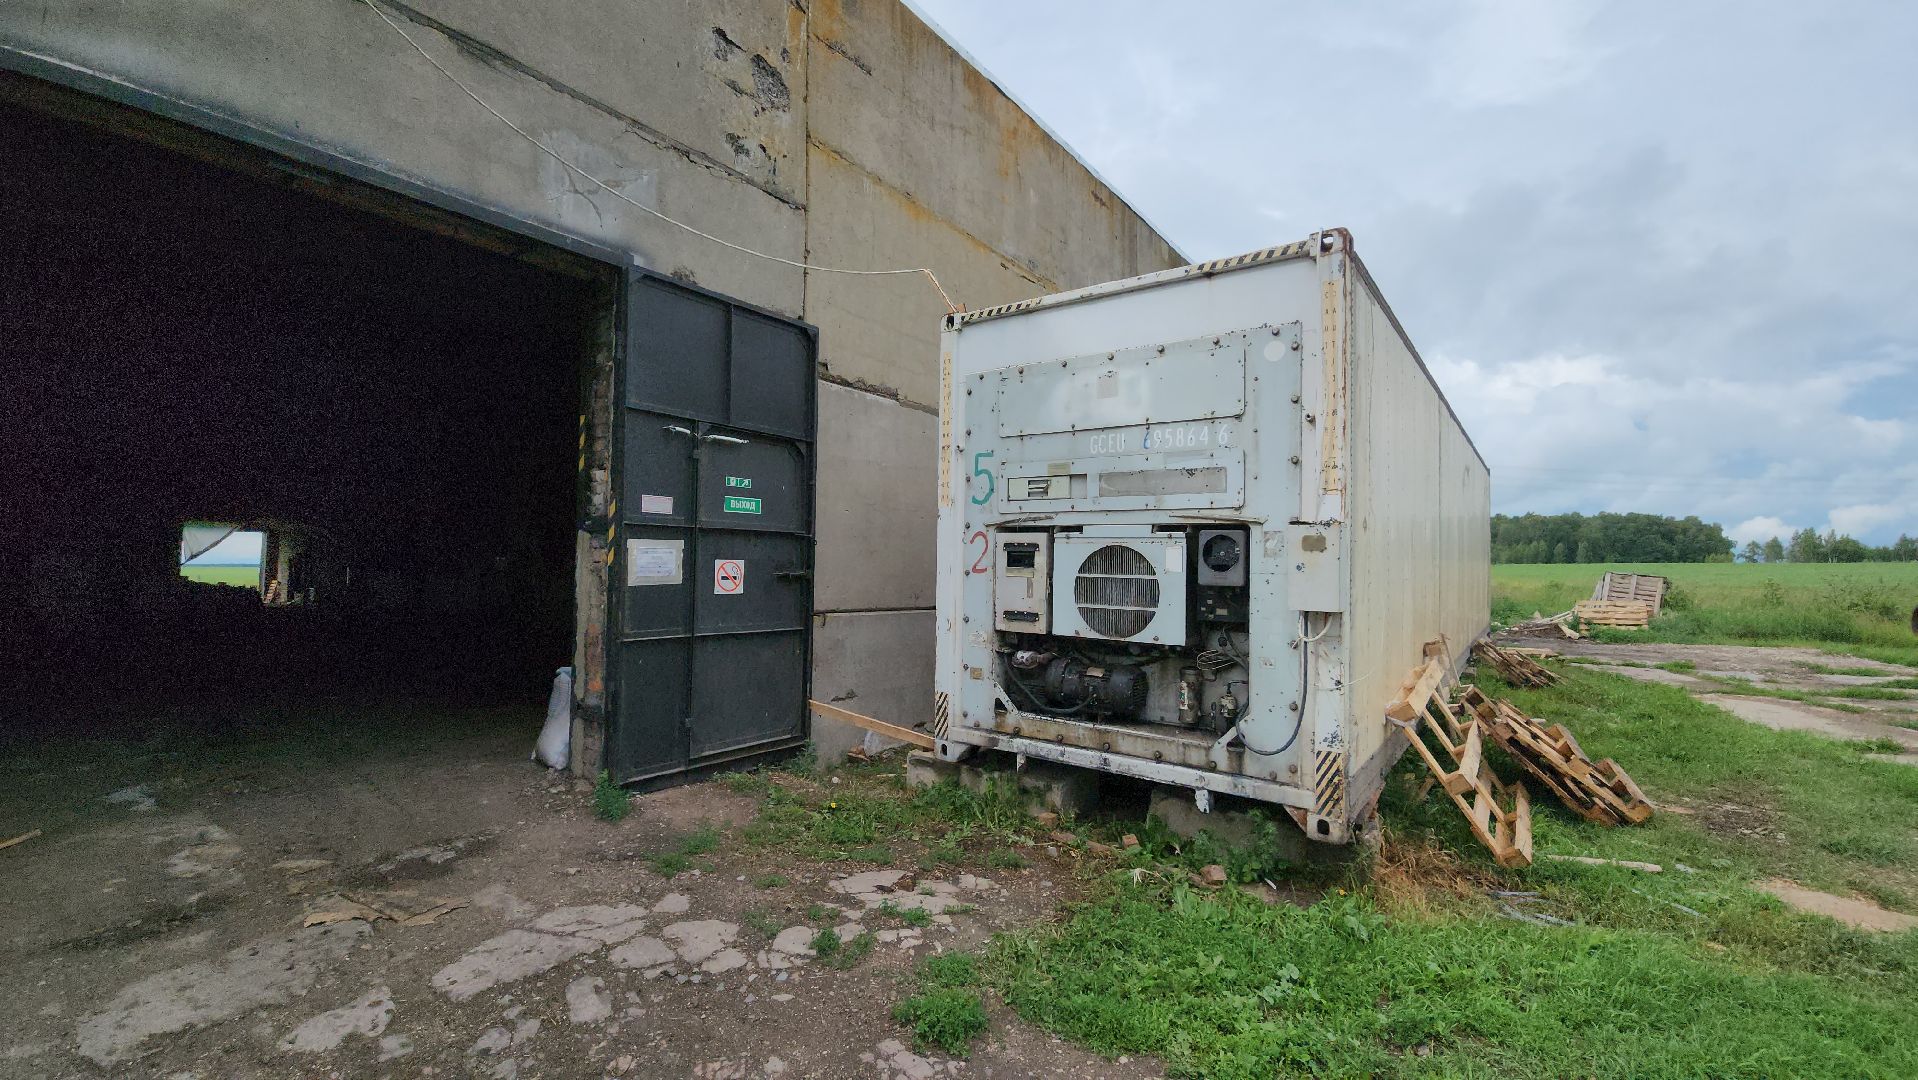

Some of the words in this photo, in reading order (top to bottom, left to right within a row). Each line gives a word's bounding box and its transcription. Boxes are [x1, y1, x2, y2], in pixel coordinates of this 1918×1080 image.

[1089, 433, 1125, 455] GCEU
[972, 452, 995, 505] 5
[730, 499, 756, 512] ВЫХОД
[970, 531, 989, 574] 2
